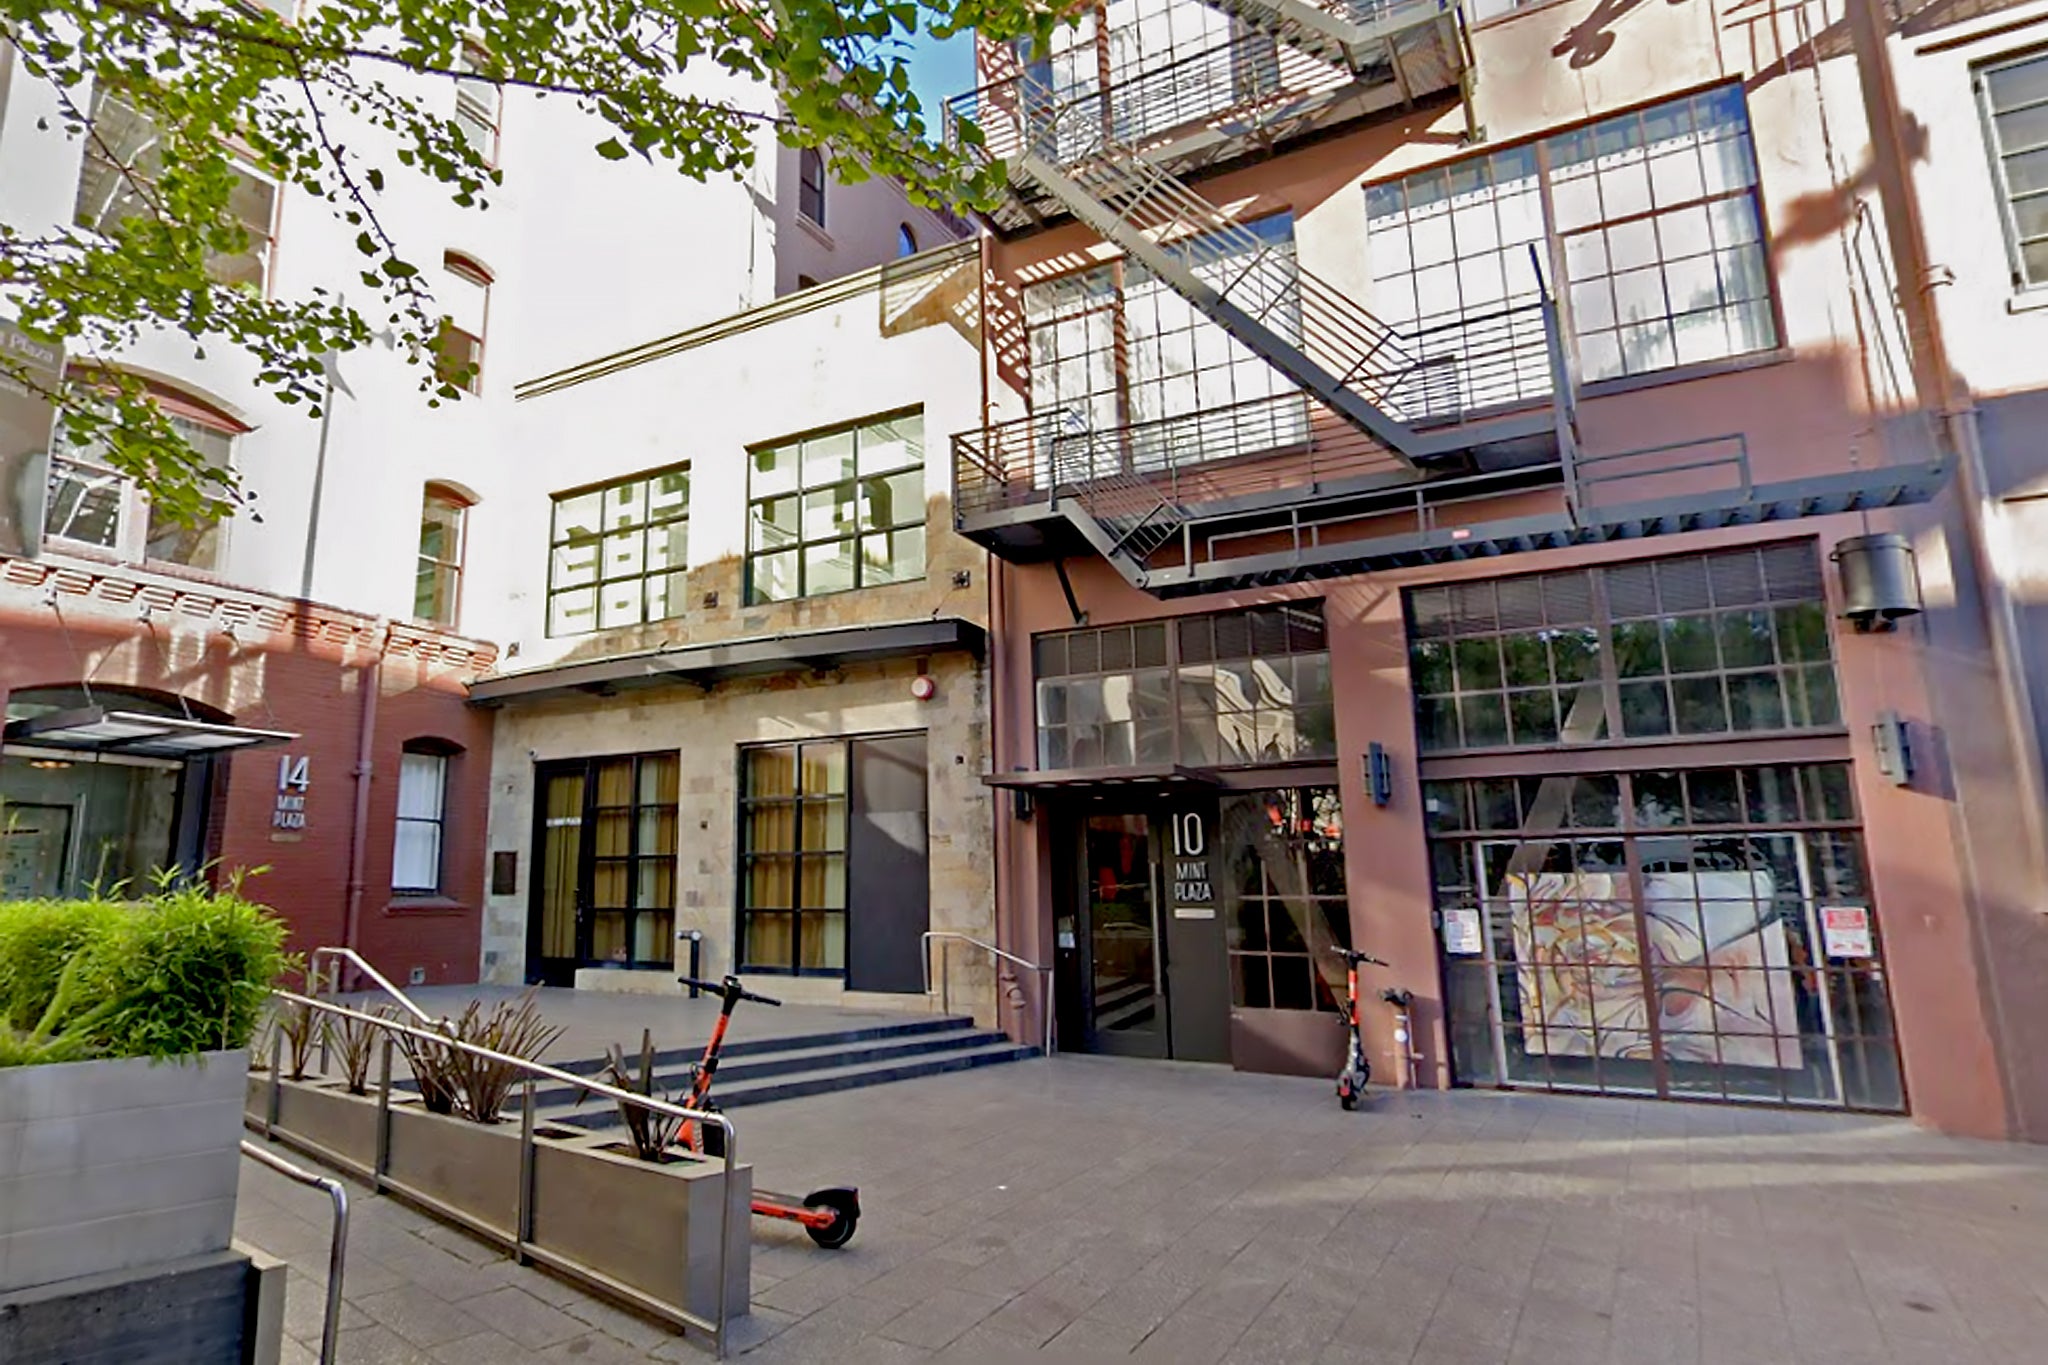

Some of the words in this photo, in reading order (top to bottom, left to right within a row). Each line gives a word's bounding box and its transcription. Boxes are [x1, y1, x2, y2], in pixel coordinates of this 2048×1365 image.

[280, 754, 310, 792] 14
[277, 795, 306, 810] MINT
[273, 810, 306, 828] PLAZA
[1172, 813, 1204, 856] 10
[1176, 862, 1207, 880] MINT
[1174, 881, 1213, 901] PLAZA
